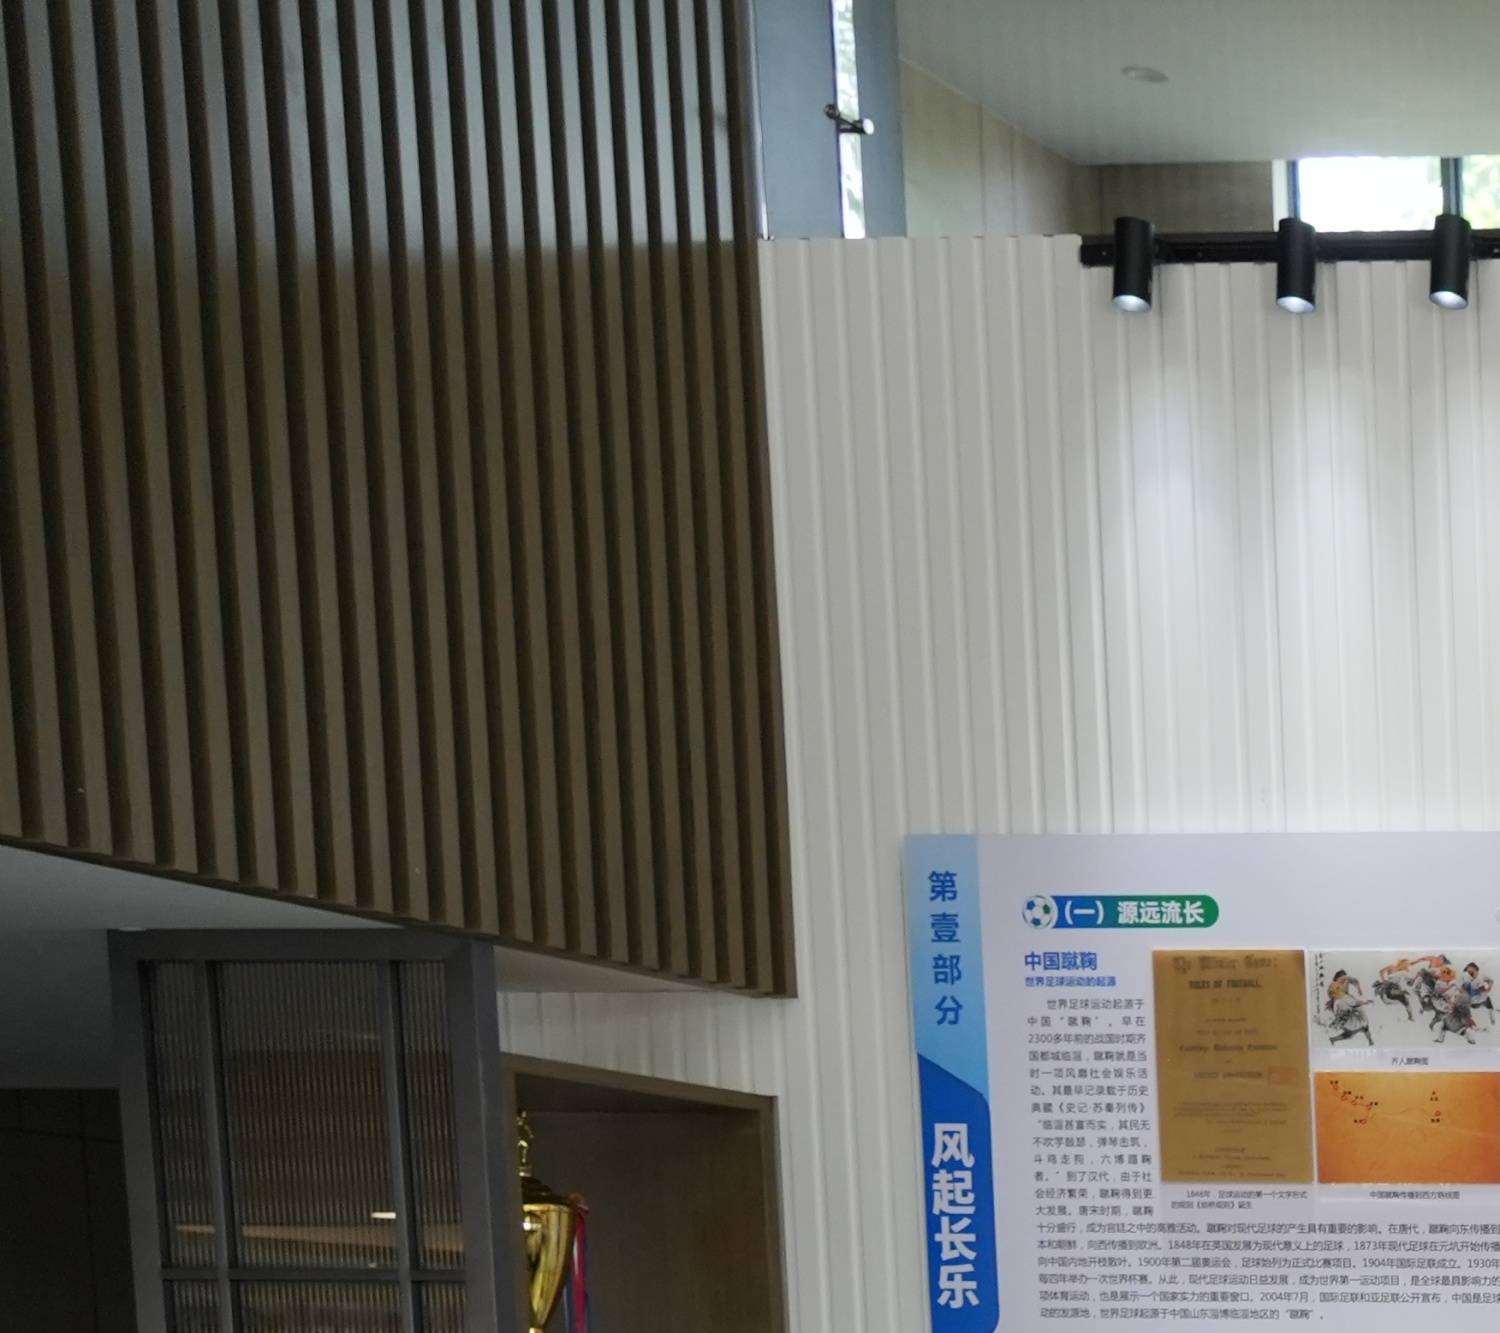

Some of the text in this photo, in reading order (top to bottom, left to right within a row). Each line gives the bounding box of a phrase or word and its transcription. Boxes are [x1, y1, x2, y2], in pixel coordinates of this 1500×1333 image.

[928, 870, 963, 1026] 第壹部分
[1024, 951, 1097, 970] 中国蹴鞠
[932, 1122, 979, 1309] 风起长乐
